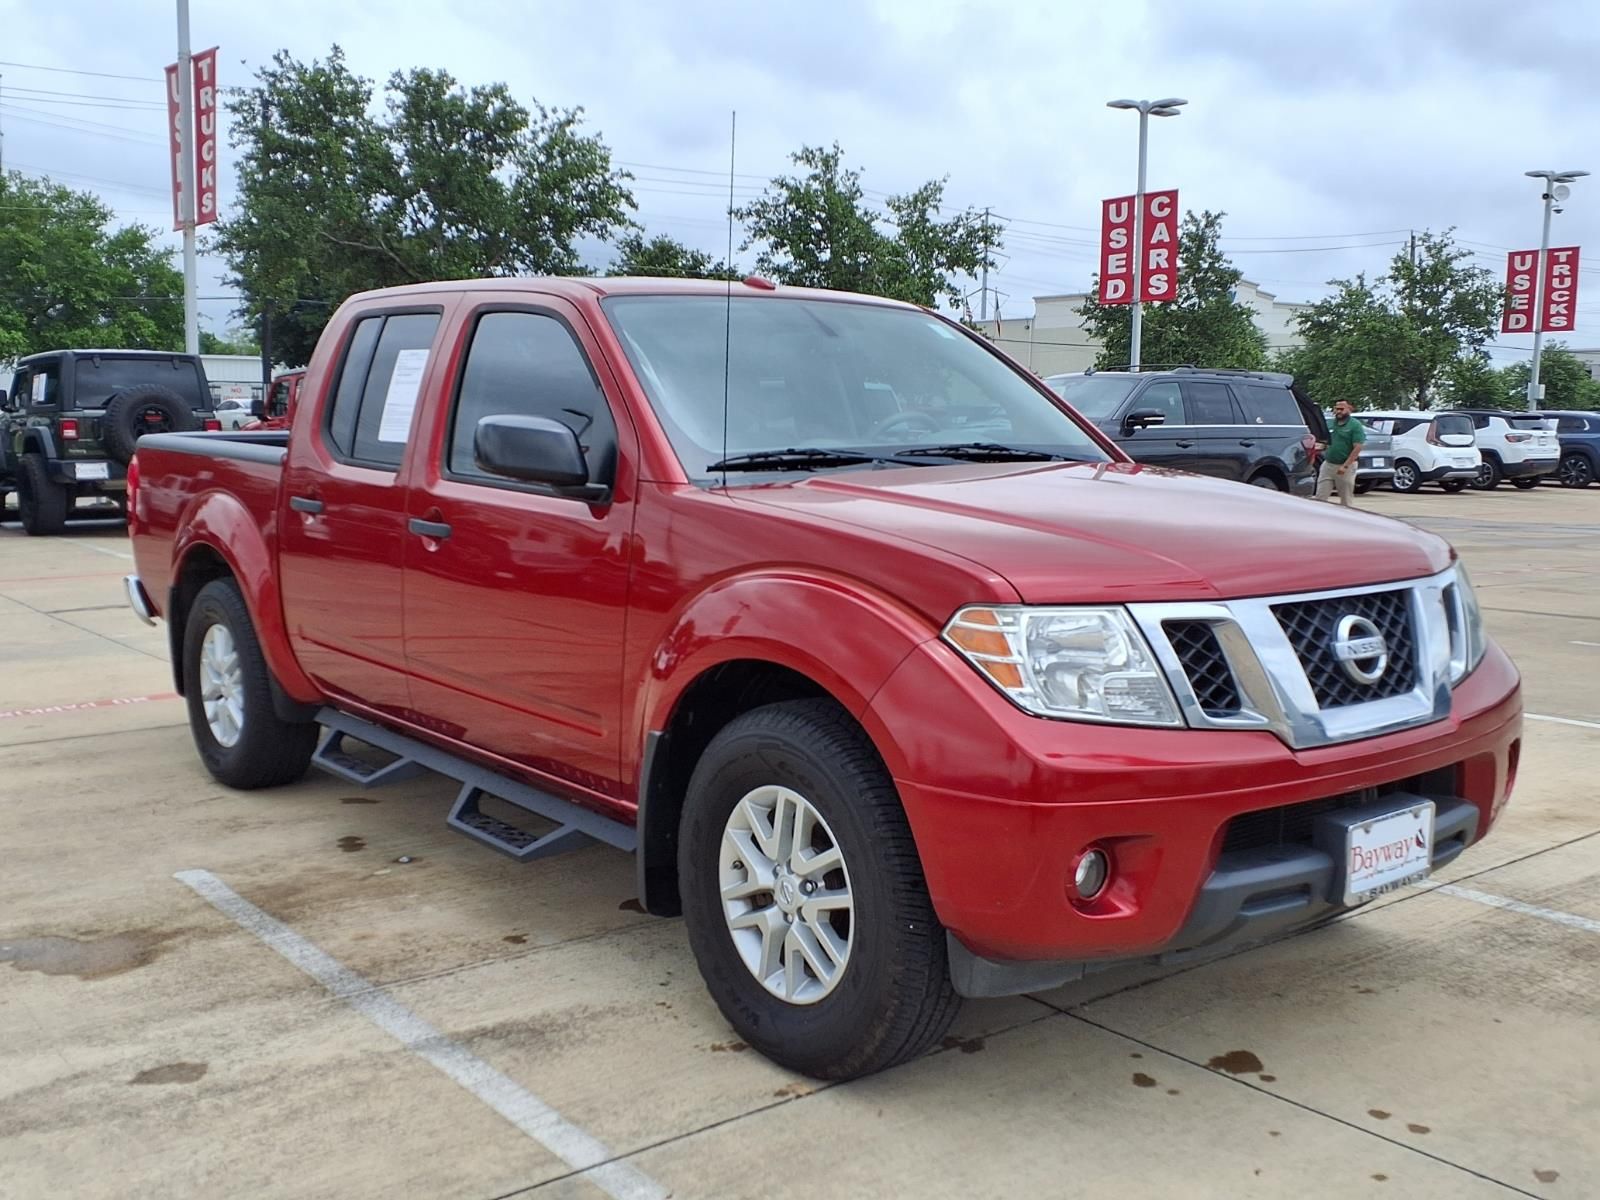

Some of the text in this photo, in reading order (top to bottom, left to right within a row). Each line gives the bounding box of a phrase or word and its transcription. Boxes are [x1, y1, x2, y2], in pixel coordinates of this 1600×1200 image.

[198, 57, 214, 214] TRUCKS
[1105, 201, 1129, 300] USED
[1148, 195, 1171, 295] CARS
[1508, 254, 1533, 329] USED
[1548, 251, 1573, 327] TRUCKS
[1349, 837, 1415, 875] Bayway
